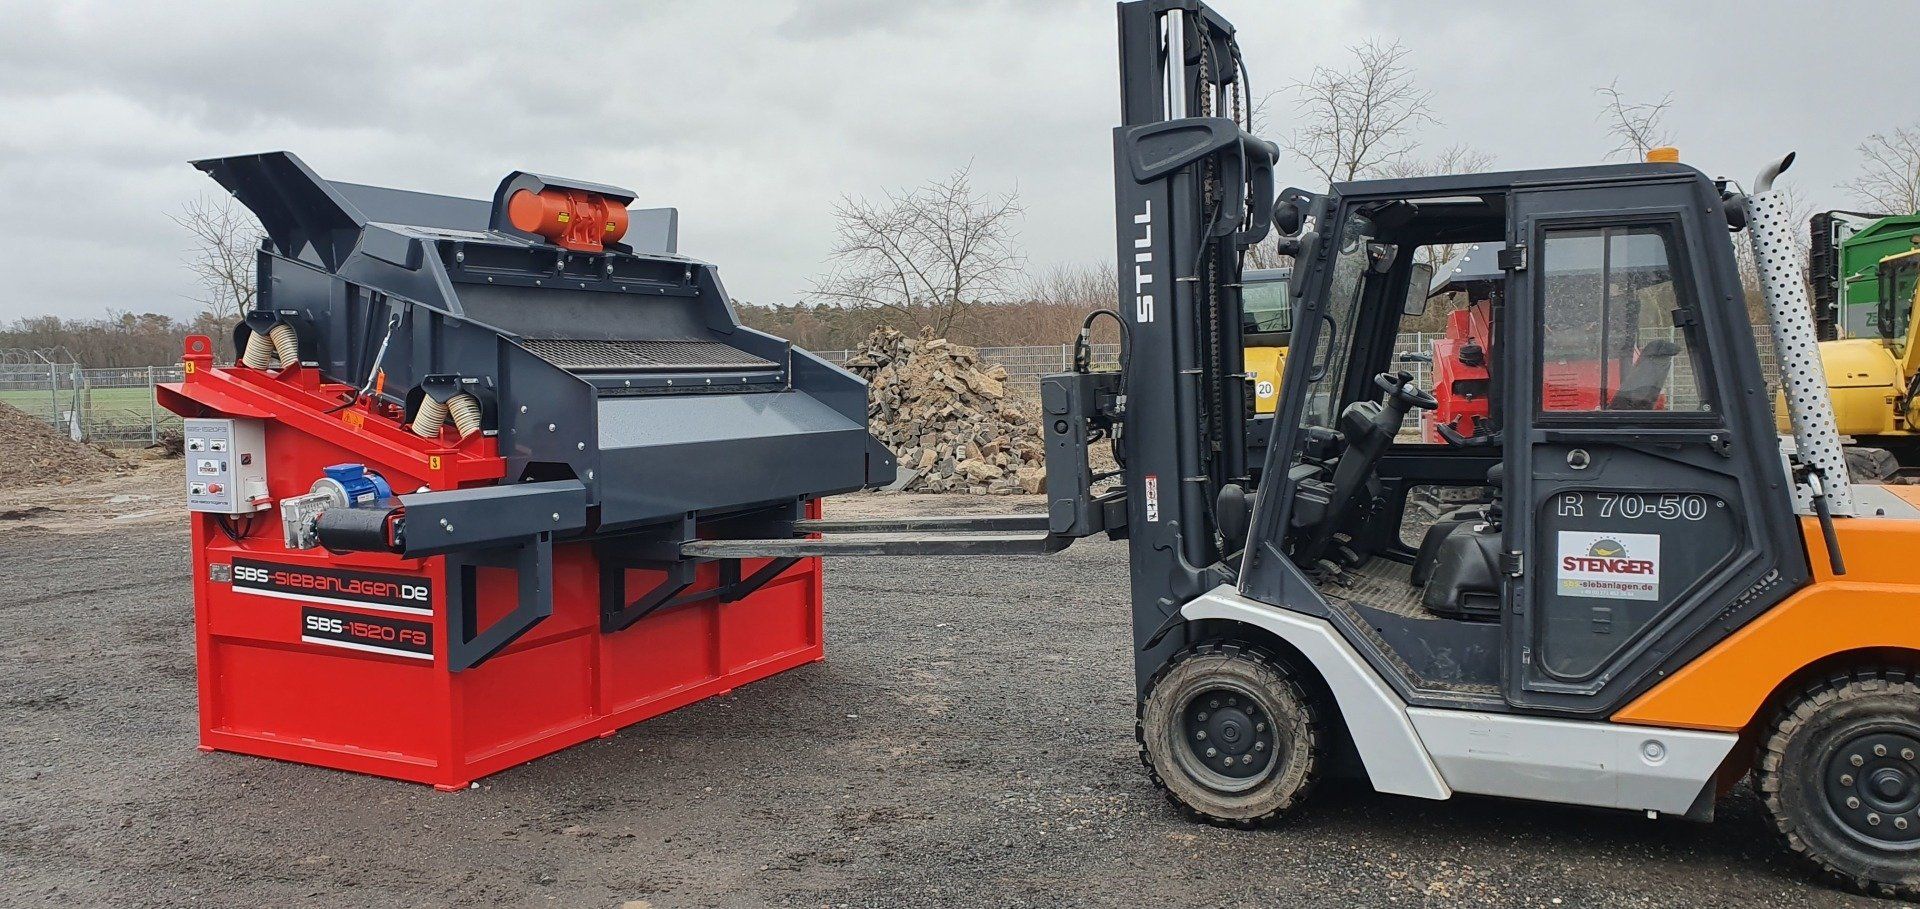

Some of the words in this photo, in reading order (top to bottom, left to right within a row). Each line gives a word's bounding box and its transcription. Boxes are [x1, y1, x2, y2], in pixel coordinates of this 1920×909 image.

[1134, 200, 1154, 323] STILL
[1258, 383, 1272, 395] 20
[1557, 493, 1584, 517] R
[1597, 493, 1707, 520] 70-50
[1563, 556, 1654, 574] STENGER
[306, 615, 396, 641] SBS-1520
[399, 628, 427, 646] F3
